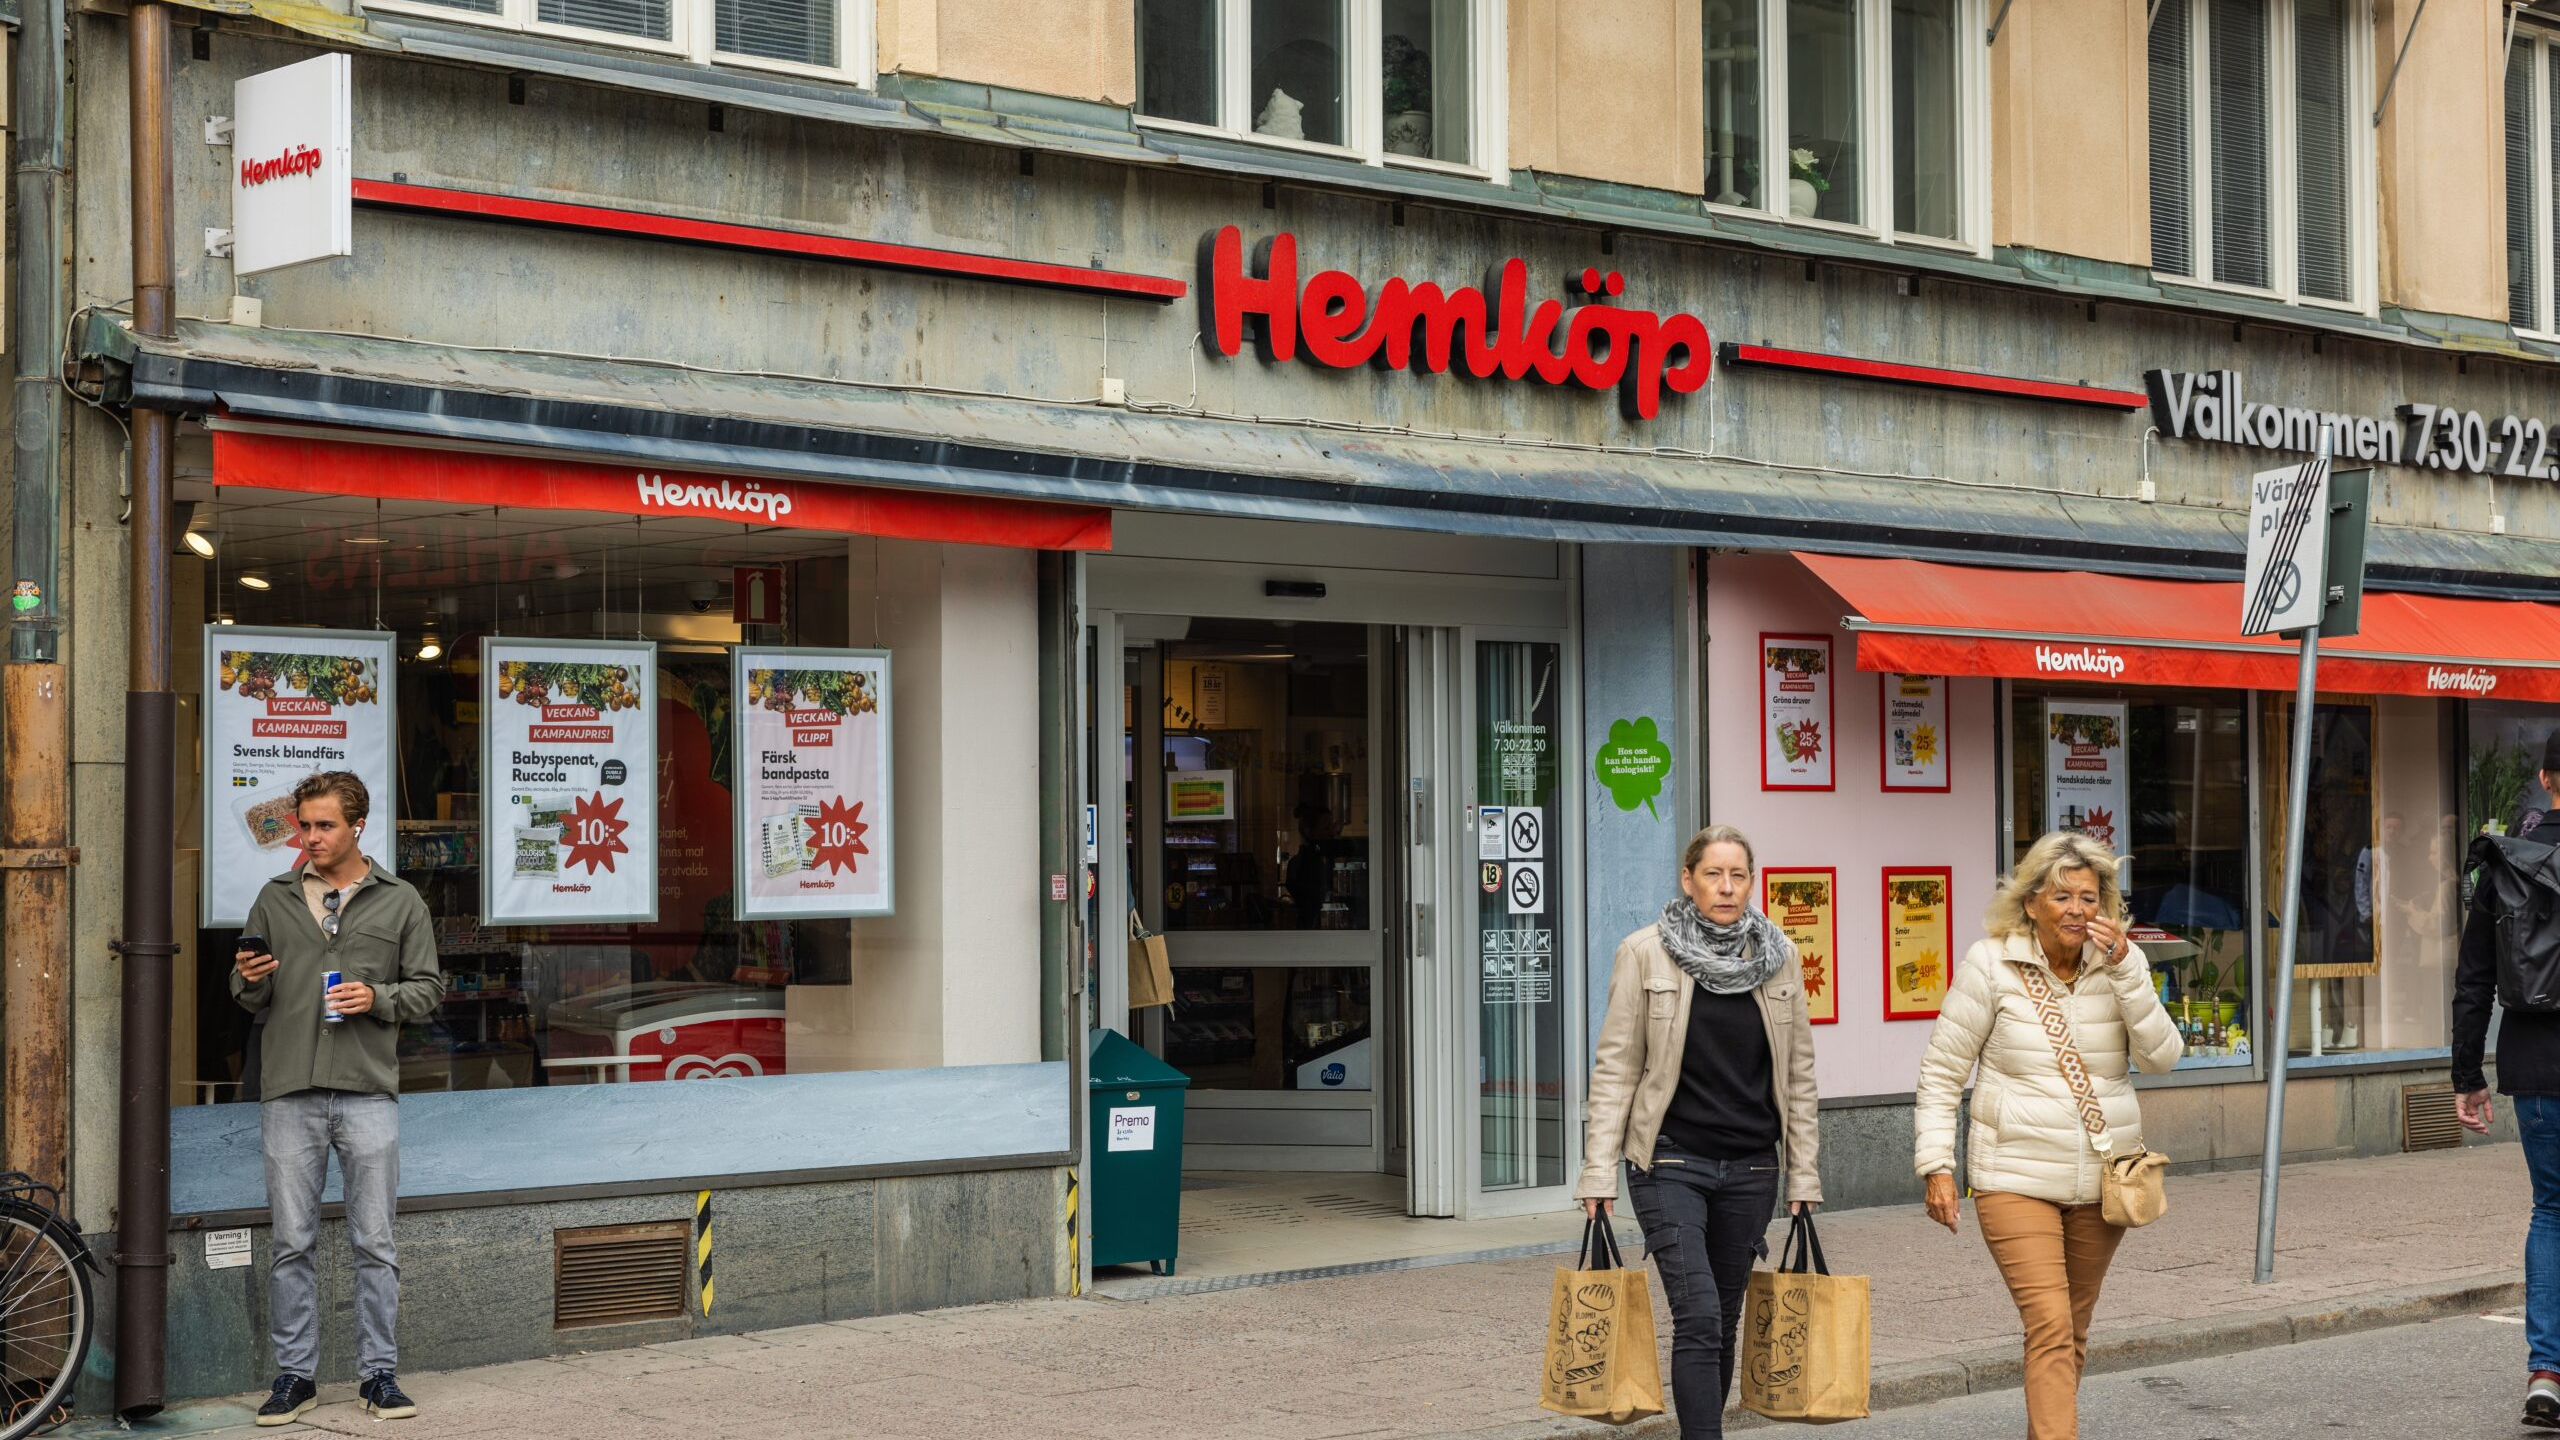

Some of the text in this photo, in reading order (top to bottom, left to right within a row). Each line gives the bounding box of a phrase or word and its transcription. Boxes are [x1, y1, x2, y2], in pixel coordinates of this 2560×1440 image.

[241, 144, 321, 187] Hemköp
[1213, 225, 1711, 420] Hemköp
[2160, 368, 2560, 483] Välkommen 7.30-22.
[637, 473, 792, 521] Hemköp
[2035, 645, 2125, 679] Hemköp
[2427, 666, 2497, 696] Hemköp
[272, 701, 327, 712] VECKANS
[1773, 696, 1811, 705] Gröna druvor
[546, 708, 596, 719] VECKANS
[790, 712, 837, 723] VECKANS
[1892, 709, 1921, 718] sköljmedel
[256, 723, 343, 735] KAMPANJPRIS!
[1493, 720, 1546, 734] Välkommen
[533, 729, 610, 740] KAMPANJPRIS!
[797, 732, 829, 743] KLIPP!
[1494, 739, 1546, 752] 7.30-22.30
[233, 744, 345, 760] Svensk blandfärs
[761, 750, 797, 764] Färsk
[512, 750, 599, 768] Babyspenat,
[1605, 757, 1620, 765] kan
[1633, 756, 1661, 764] handla
[2067, 760, 2105, 768] KAMPANJPRIS!
[512, 768, 567, 782] Ruccola
[761, 766, 830, 783] bandpasta
[1611, 765, 1655, 775] ekologiskt!
[2057, 775, 2112, 785] Handskalade räkor
[672, 862, 708, 876] utvalda
[1485, 866, 1497, 882] 18
[552, 883, 591, 893] Hemköp
[799, 880, 835, 889] Hemköp
[1895, 927, 1910, 935] Smör
[1322, 1070, 1343, 1080] Valio
[1115, 1115, 1149, 1127] Premo
[214, 1232, 242, 1240] Varning
